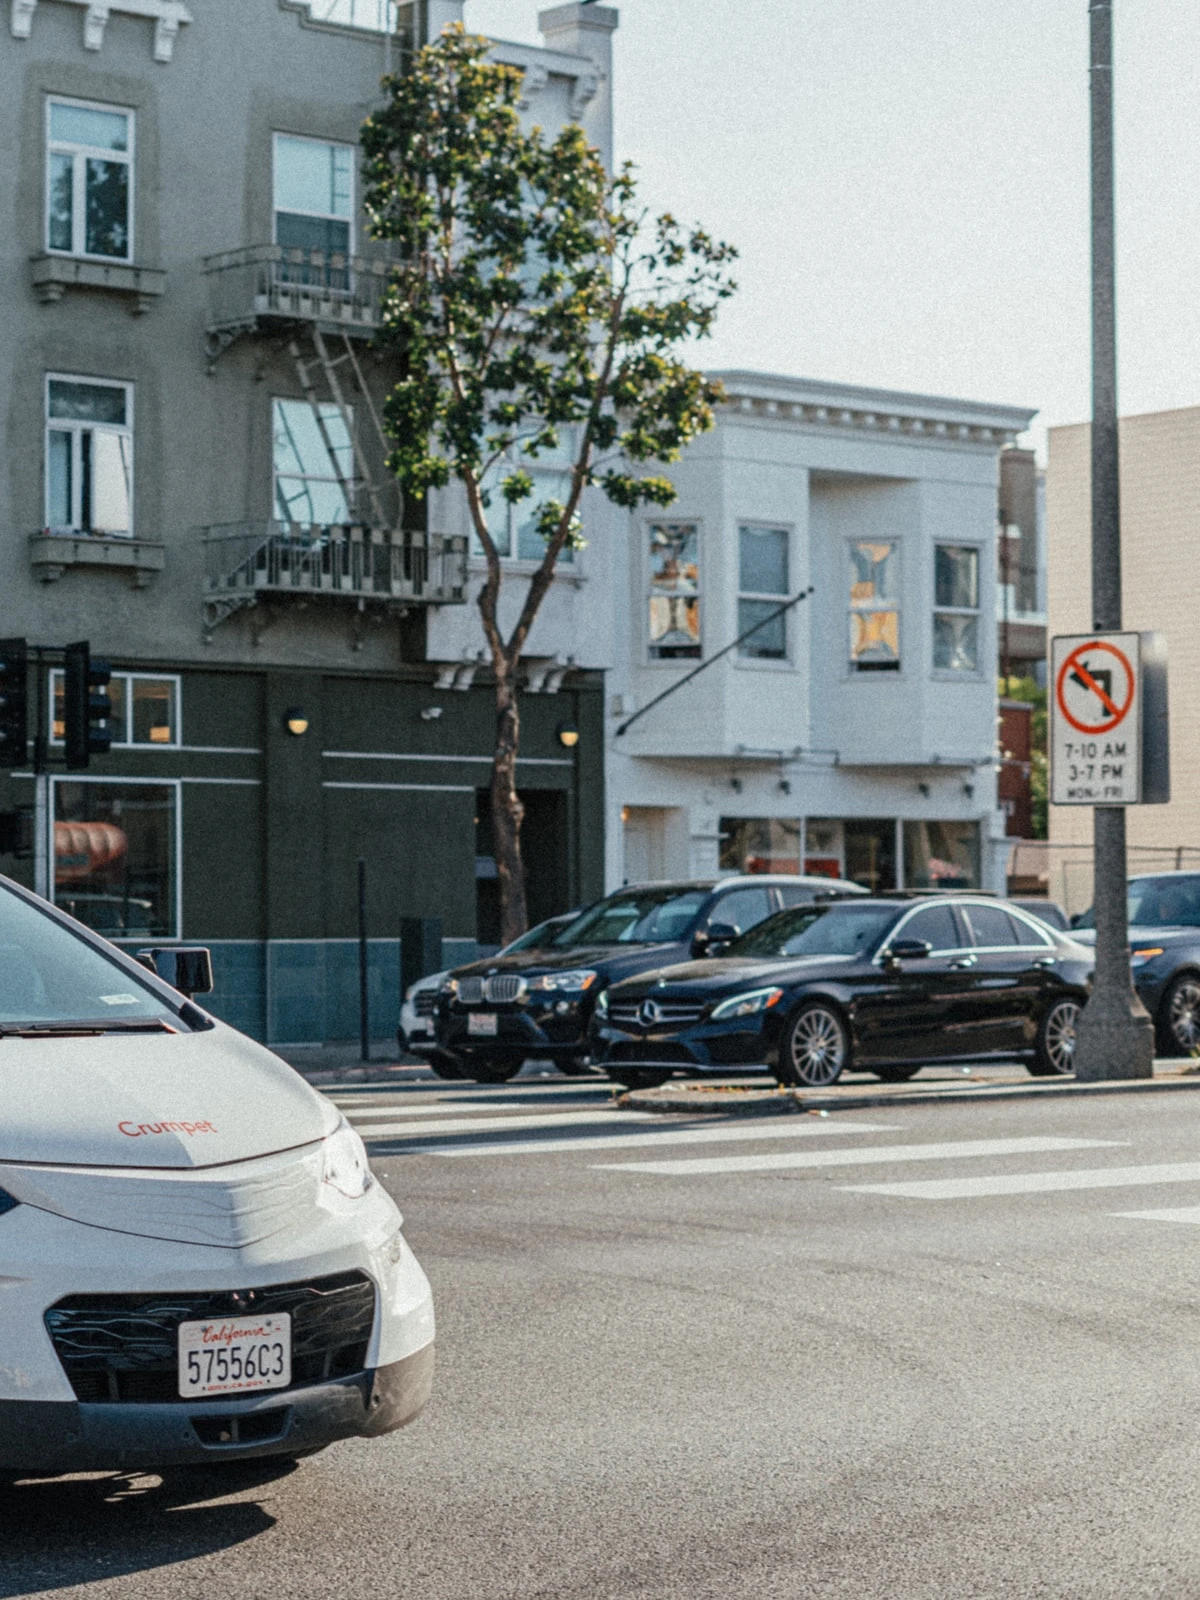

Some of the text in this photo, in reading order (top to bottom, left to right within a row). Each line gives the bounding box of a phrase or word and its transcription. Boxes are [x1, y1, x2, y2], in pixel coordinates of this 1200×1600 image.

[1064, 743, 1126, 759] 7-10 AM
[1069, 764, 1123, 781] 3-7 PM
[117, 1120, 218, 1137] Crumpet
[202, 1324, 271, 1346] California
[188, 1343, 283, 1384] 57556C3
